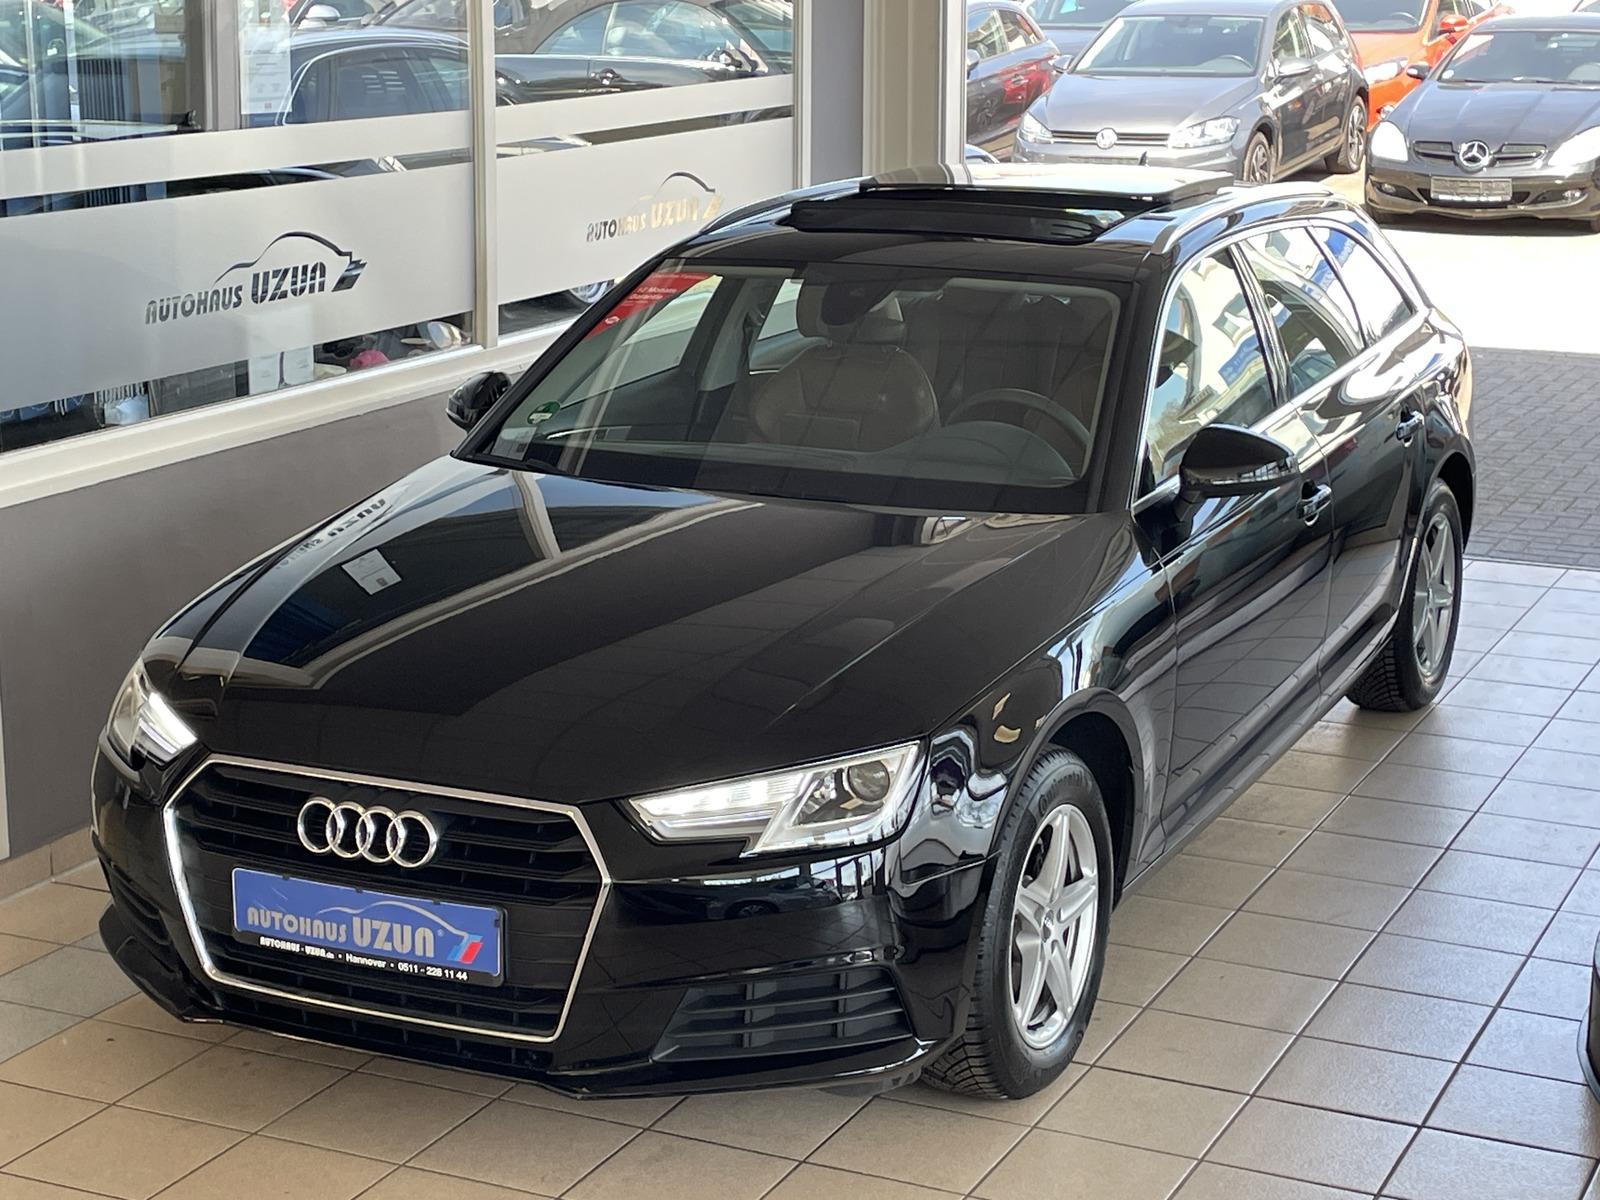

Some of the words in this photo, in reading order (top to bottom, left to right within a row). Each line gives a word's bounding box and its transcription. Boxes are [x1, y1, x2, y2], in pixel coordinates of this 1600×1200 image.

[586, 212, 646, 242] AUTOHAUS
[145, 285, 243, 325] AUTOHAUS
[251, 261, 326, 304] UZUN
[247, 907, 347, 943] AUTOHAUS
[352, 916, 435, 958] UZUN
[345, 953, 387, 968] Hannover
[398, 962, 418, 974] 0511
[444, 969, 454, 979] 11
[455, 971, 468, 981] 44
